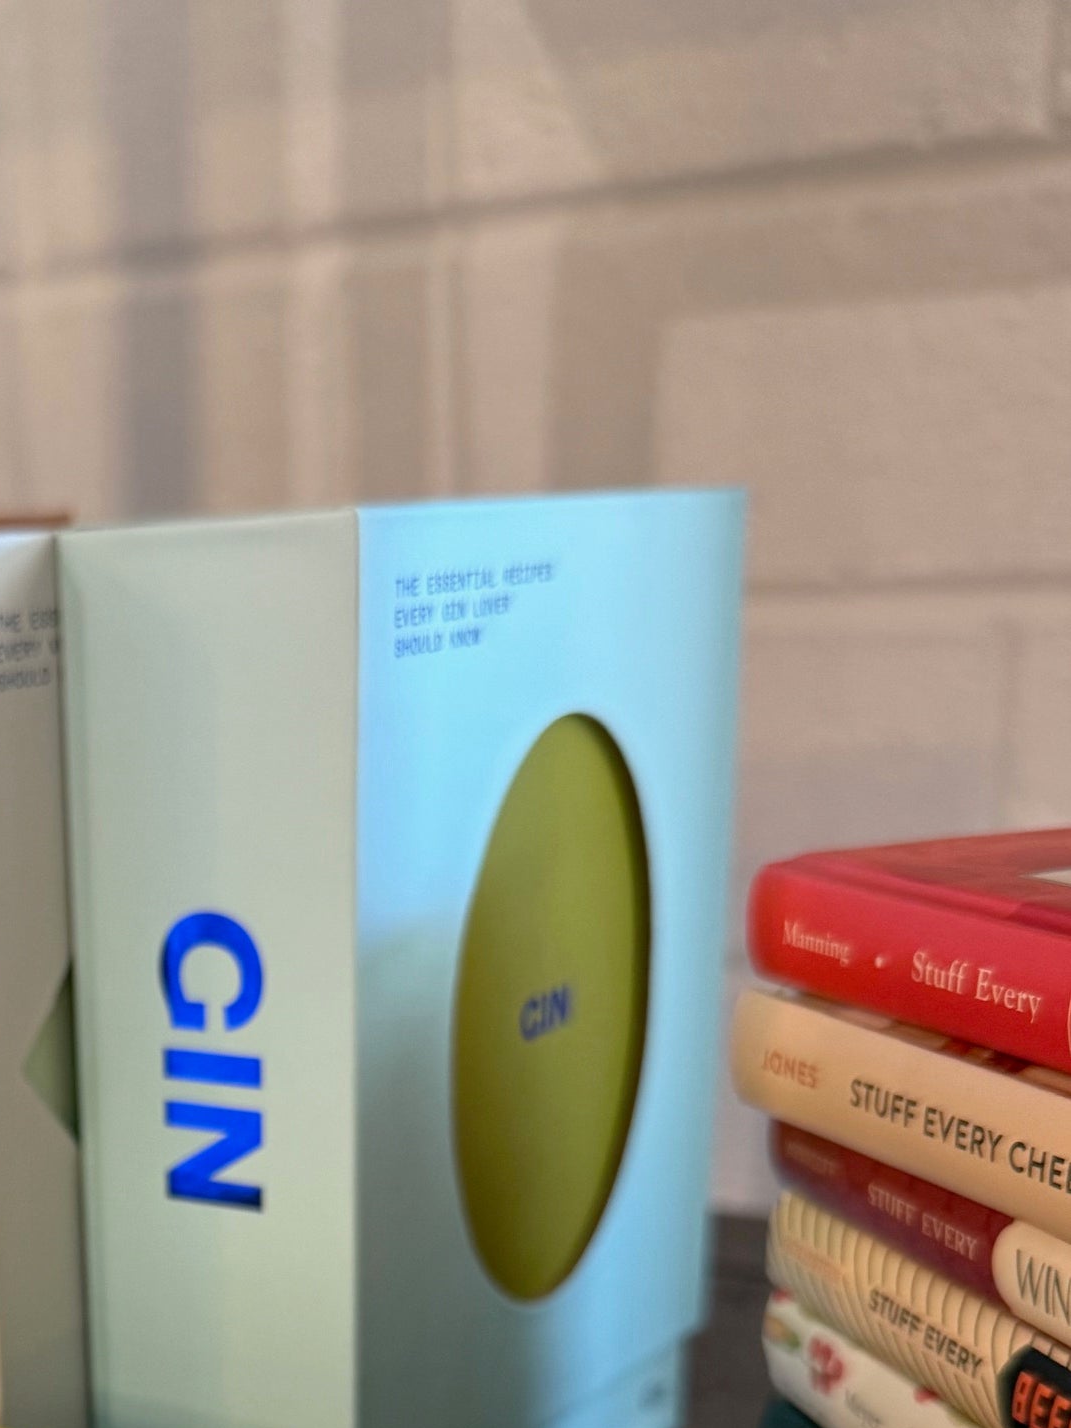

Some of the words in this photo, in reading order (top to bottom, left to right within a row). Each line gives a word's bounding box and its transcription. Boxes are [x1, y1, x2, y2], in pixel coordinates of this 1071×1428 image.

[394, 604, 434, 629] EVERY
[442, 598, 467, 622] GIN
[473, 594, 511, 618] LOVER
[395, 576, 420, 598] THE
[427, 569, 498, 595] ESSENTIAL
[394, 632, 443, 658] SHOULD
[449, 626, 482, 648] KNOW
[783, 919, 850, 966] Manning
[911, 950, 967, 994] Stuff
[975, 967, 1042, 1024] Every
[519, 983, 571, 1041] GIN
[158, 910, 264, 1213] GIN
[762, 1051, 818, 1089] JONES
[850, 1078, 917, 1128] STUFF
[923, 1106, 1003, 1162] EVERY
[868, 1182, 917, 1227] STUFF
[922, 1213, 977, 1260] EVERY
[869, 1289, 921, 1336] STUFF
[924, 1323, 984, 1379] EVERY
